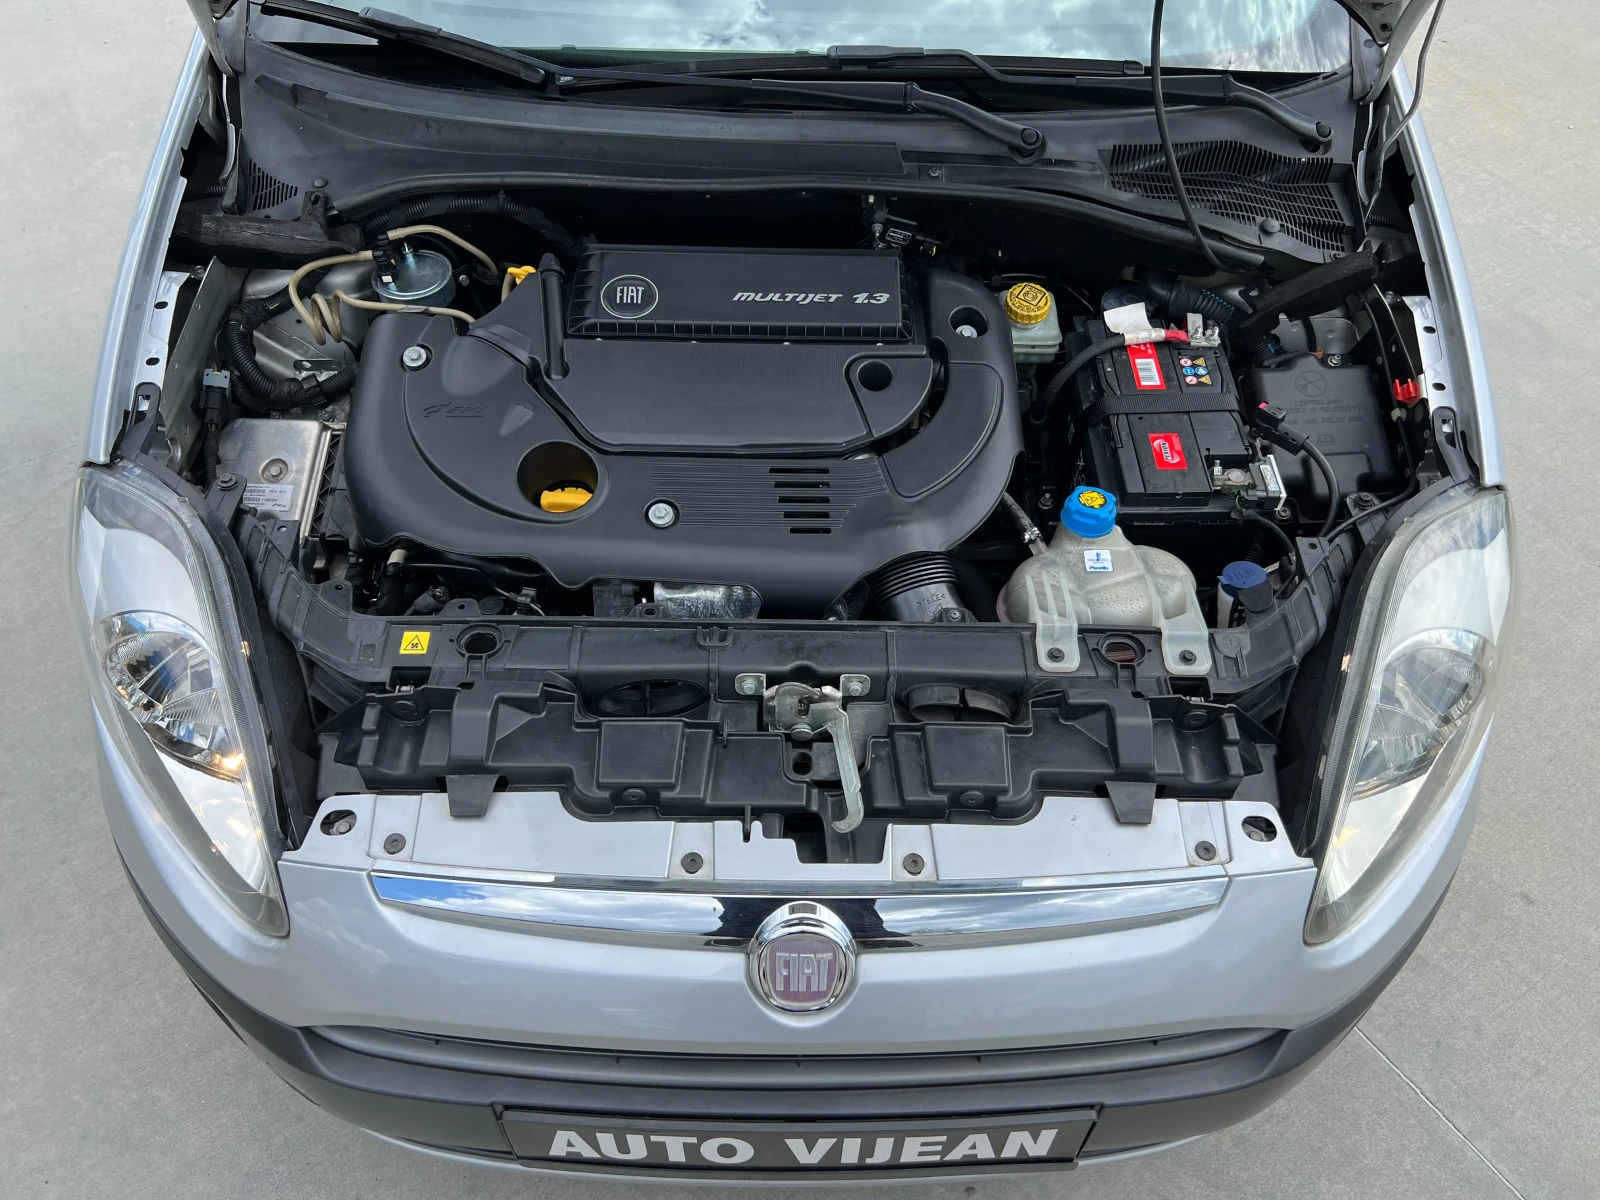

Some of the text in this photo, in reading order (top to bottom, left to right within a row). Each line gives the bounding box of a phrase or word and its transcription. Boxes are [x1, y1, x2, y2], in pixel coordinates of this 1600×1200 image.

[616, 286, 645, 304] FIAT
[732, 292, 890, 305] MULTIJET 1.3
[775, 951, 834, 992] FIAT
[548, 1128, 1059, 1165] AUTO VIJEAN
